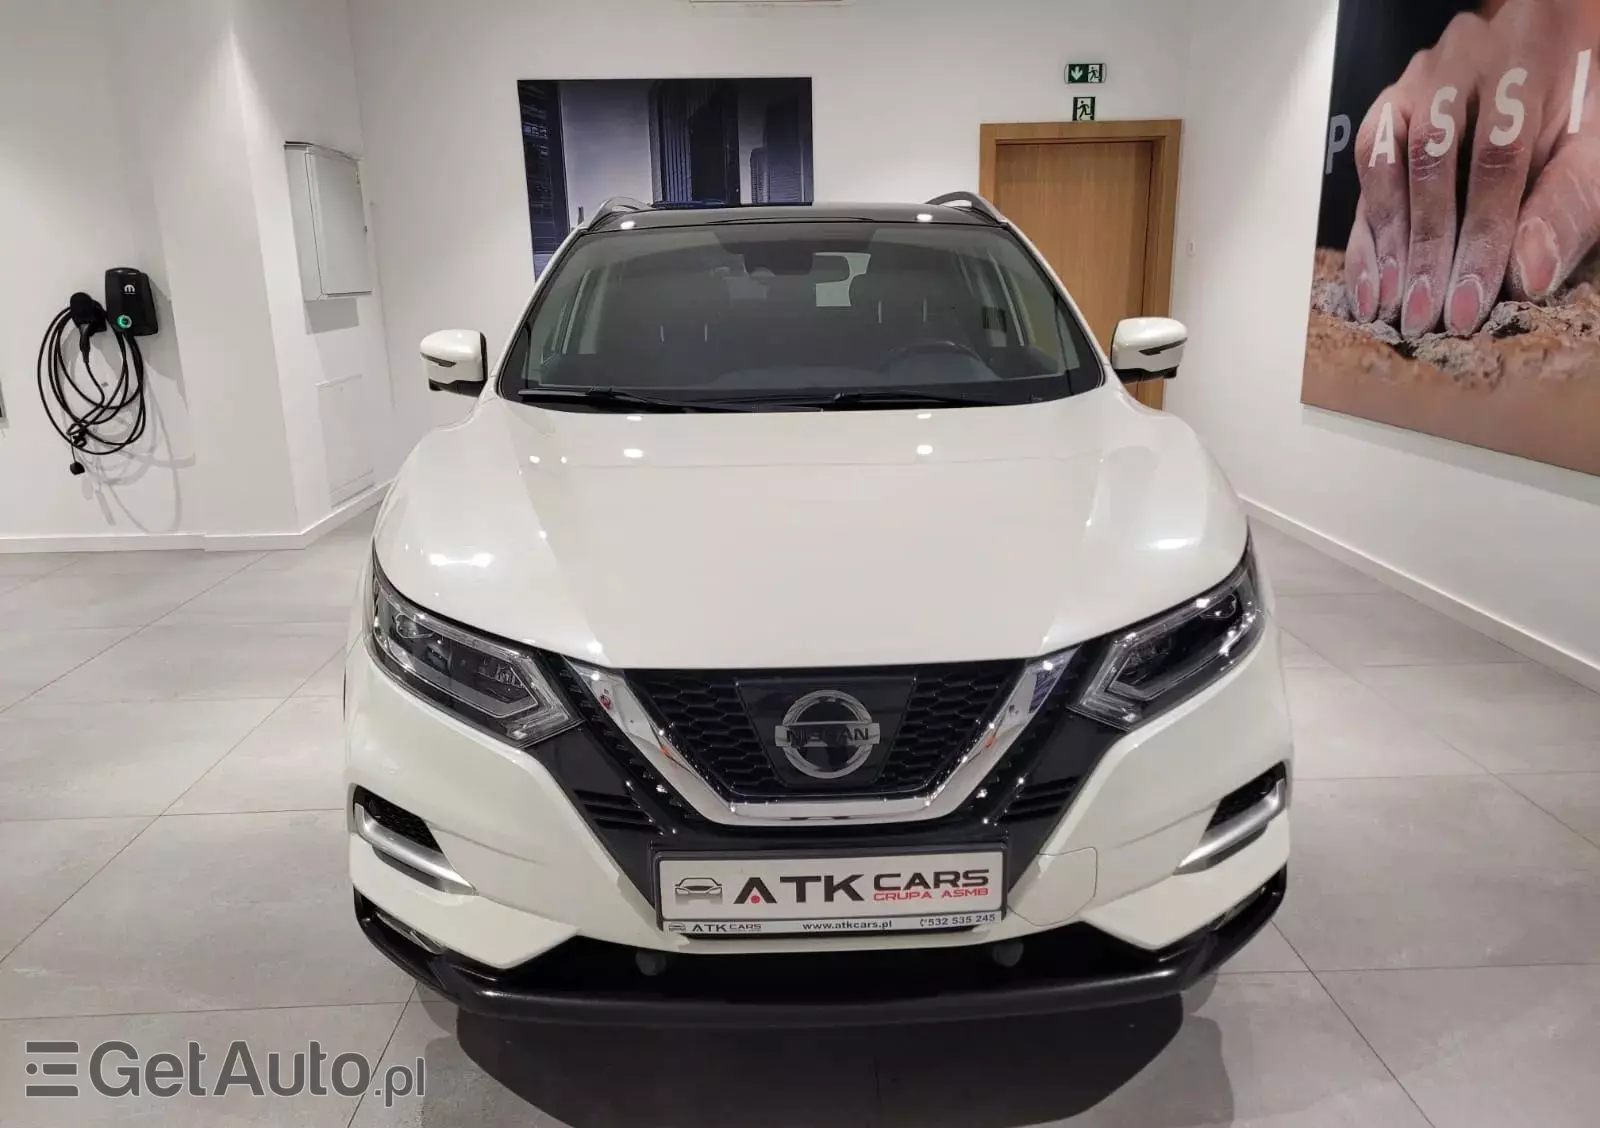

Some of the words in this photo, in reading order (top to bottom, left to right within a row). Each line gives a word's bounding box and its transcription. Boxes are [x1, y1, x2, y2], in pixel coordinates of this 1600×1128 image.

[1326, 49, 1592, 175] PASSI
[733, 874, 865, 905] ATK
[873, 869, 990, 891] CARS
[873, 891, 933, 901] GRUPA
[941, 887, 989, 898] ASMB
[802, 920, 893, 930] www.atkcars.pl
[927, 918, 949, 927] 532
[951, 916, 973, 926] 535
[975, 914, 996, 923] 245
[692, 924, 727, 932] ATK
[729, 923, 762, 931] CARS
